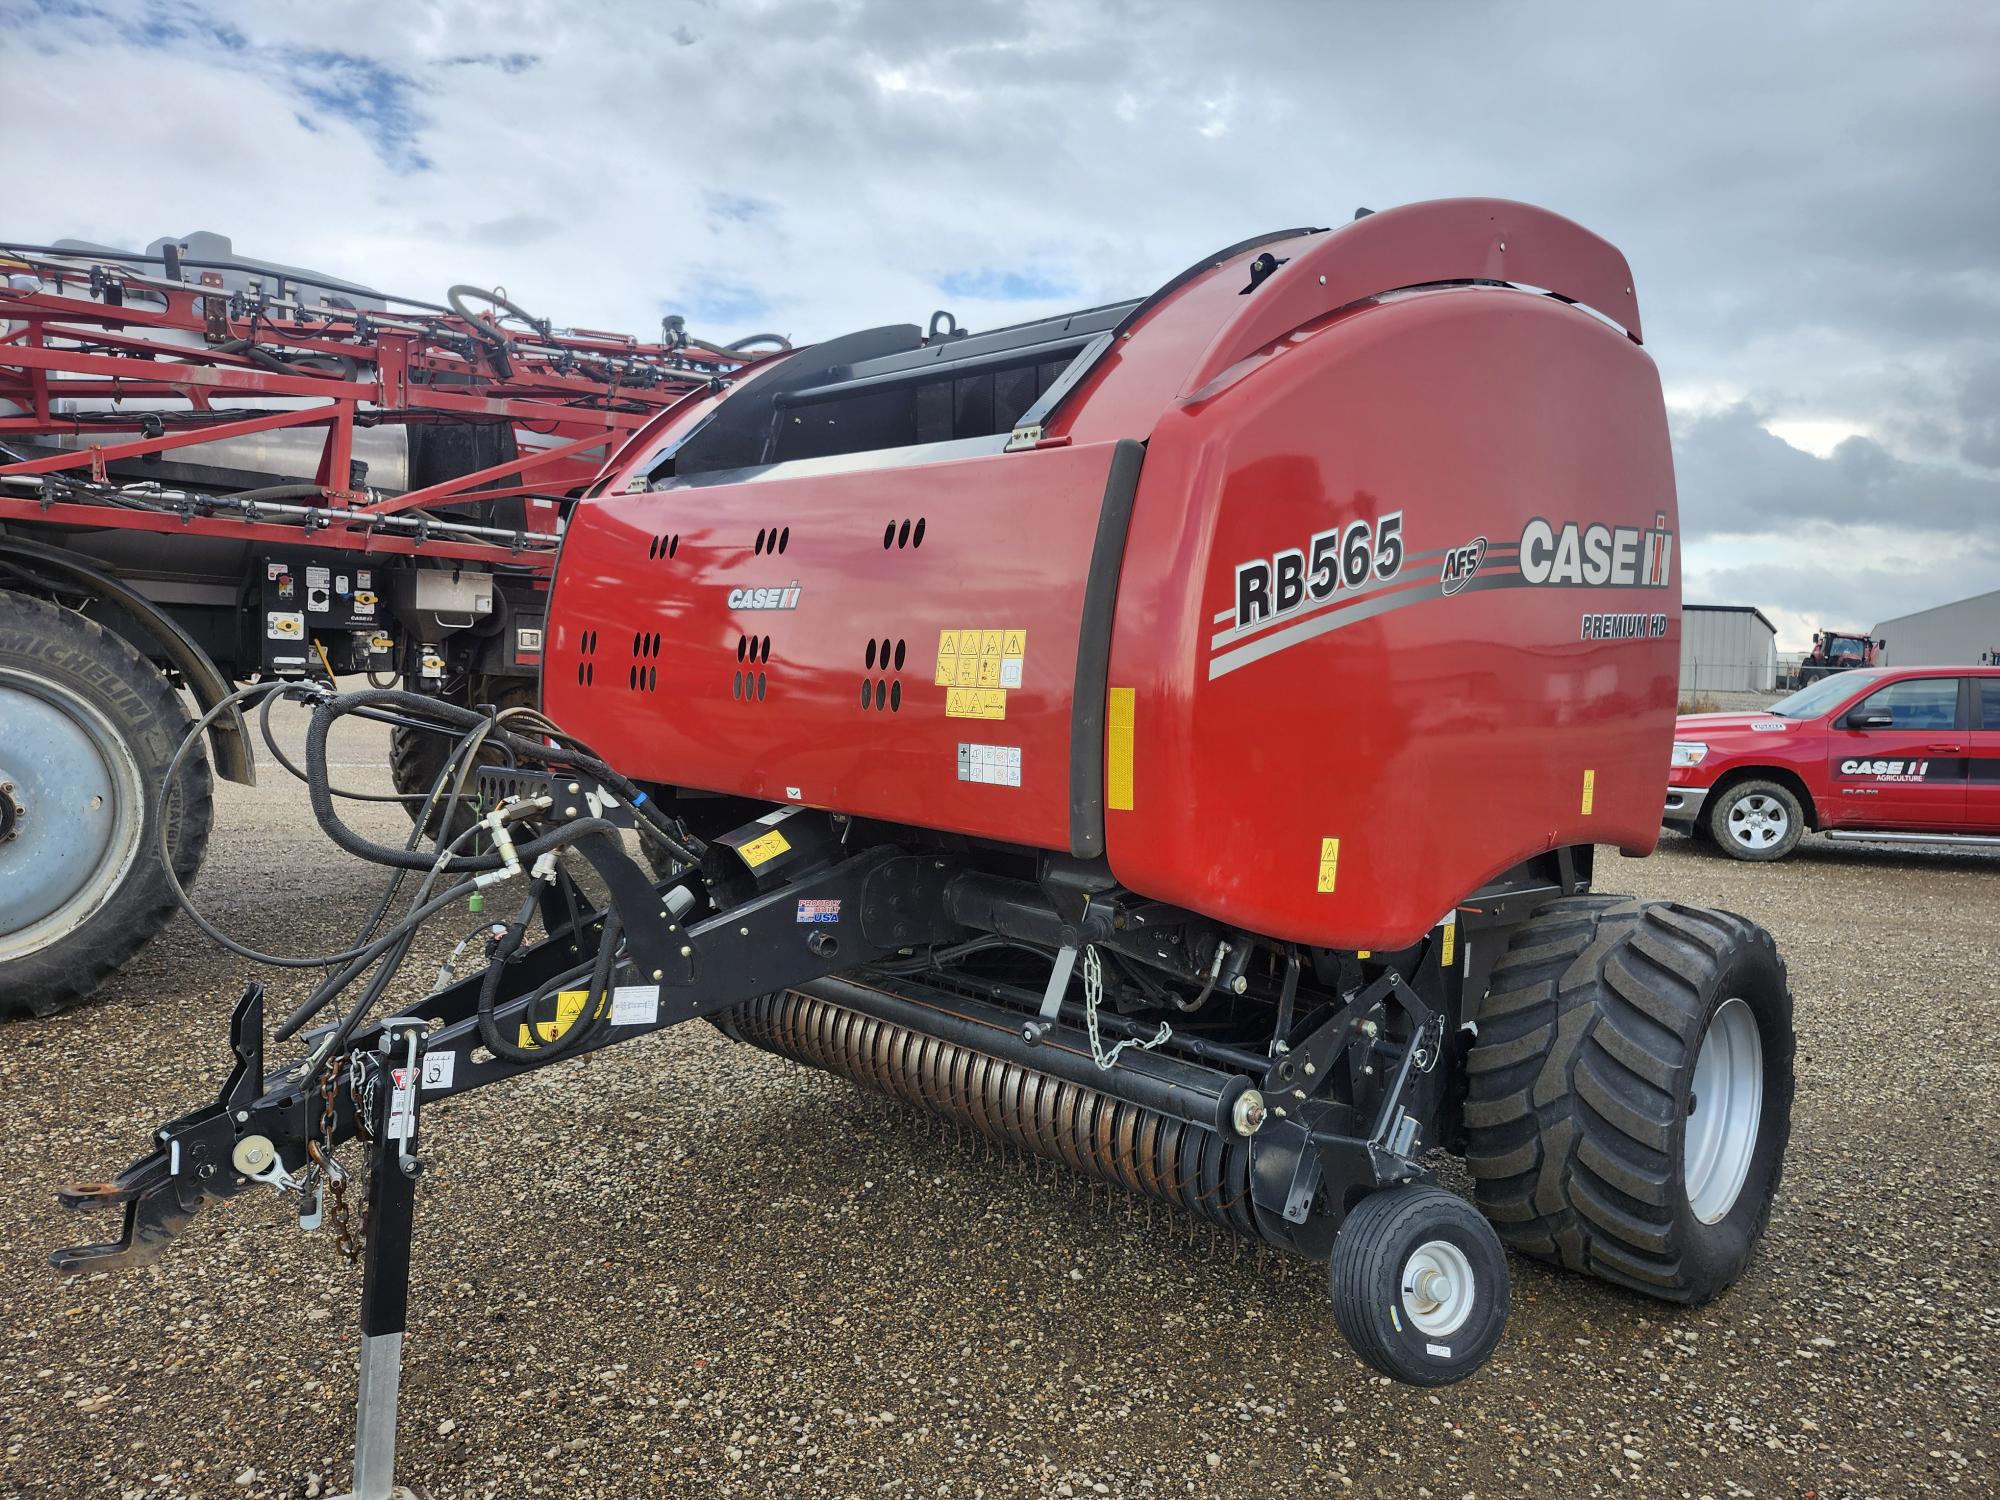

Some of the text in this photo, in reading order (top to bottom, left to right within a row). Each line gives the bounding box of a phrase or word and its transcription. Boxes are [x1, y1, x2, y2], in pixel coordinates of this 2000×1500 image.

[1519, 519, 1639, 586] CASE
[1235, 511, 1404, 633] RB565
[1440, 546, 1479, 582] AFS
[1581, 613, 1668, 640] PREMIUM HD
[1840, 760, 1905, 775] CASE
[1876, 774, 1924, 783] AGRICULTURE
[799, 899, 842, 907] PROUDLY
[814, 912, 839, 922] USA
